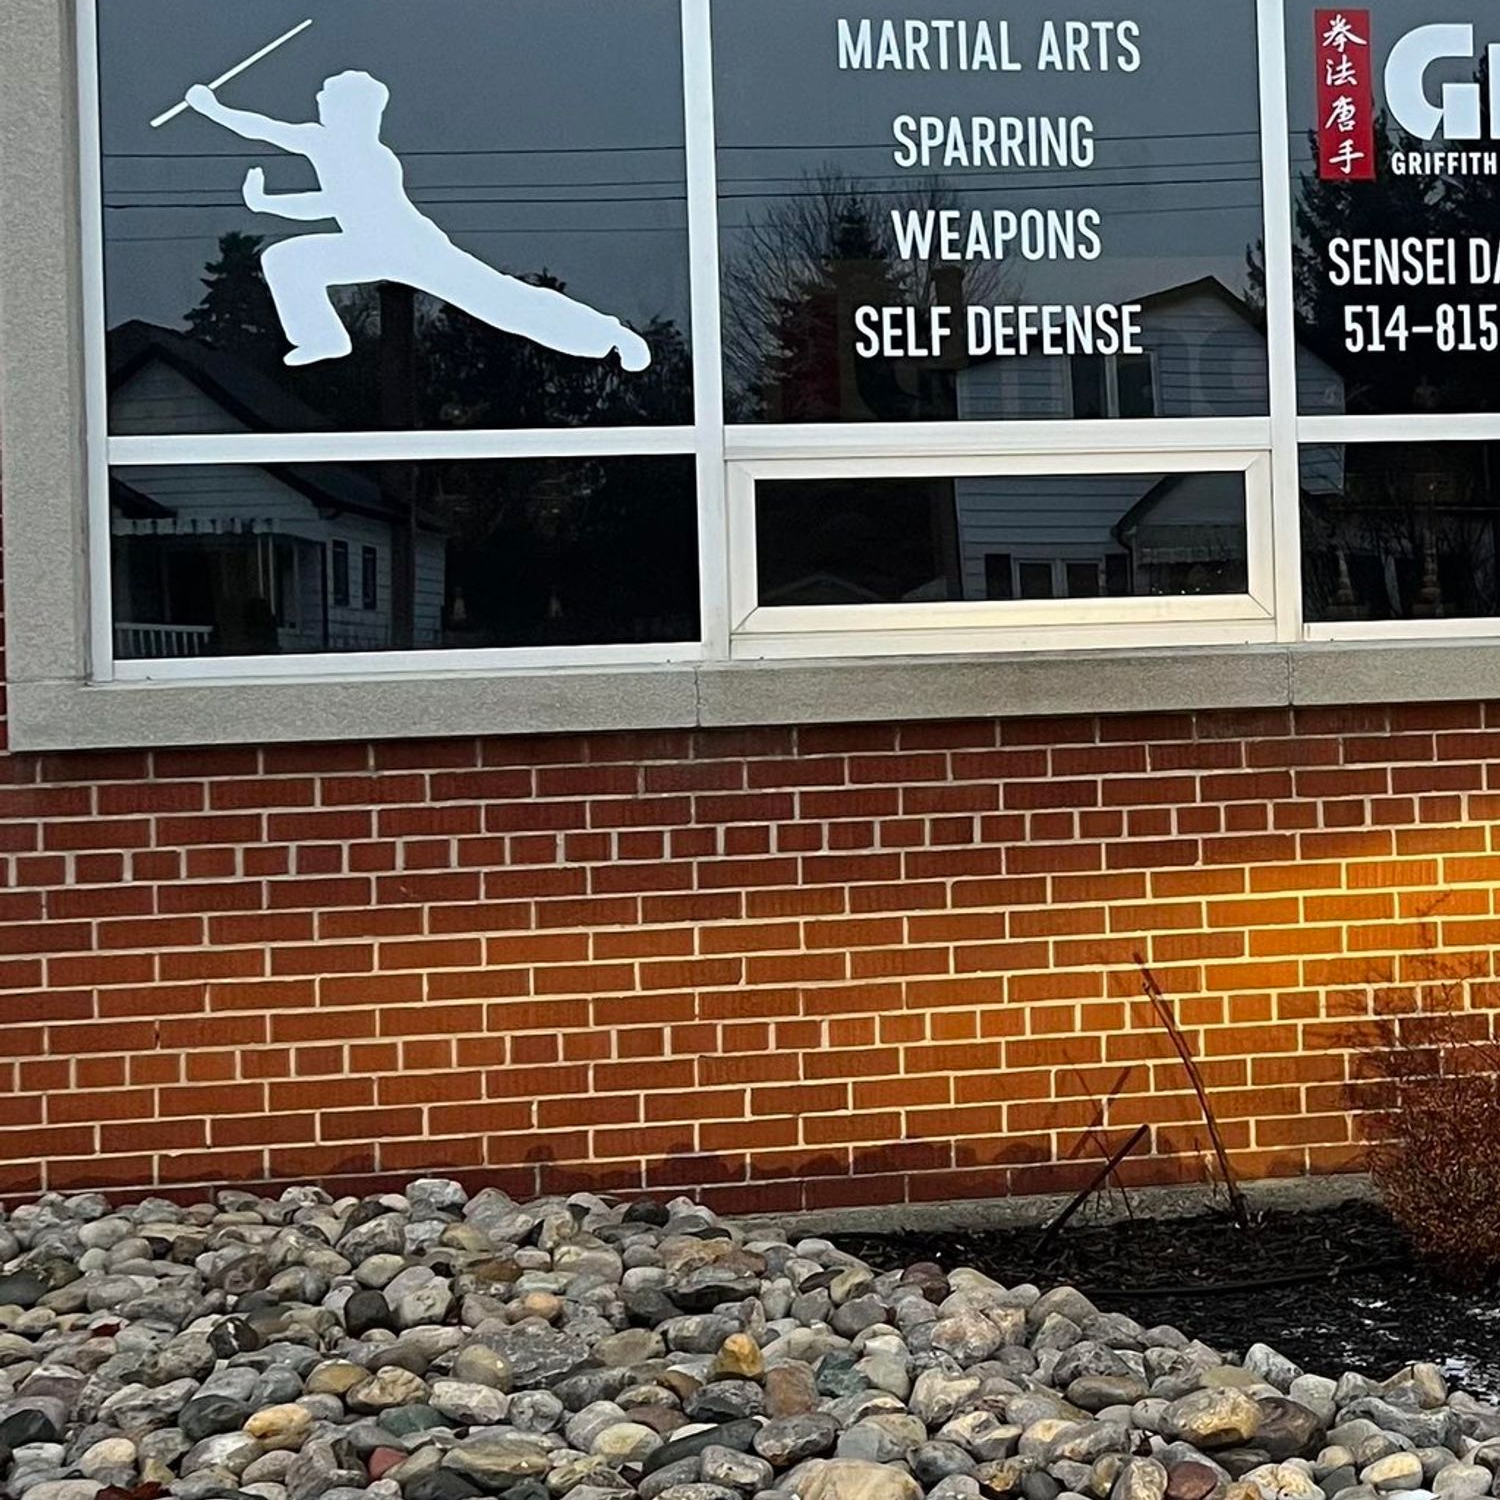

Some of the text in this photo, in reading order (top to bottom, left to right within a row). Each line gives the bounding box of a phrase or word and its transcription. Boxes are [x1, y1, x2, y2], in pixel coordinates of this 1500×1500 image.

[837, 18, 1141, 72] MARTIAL ARTS
[893, 114, 1096, 168] SPARRING
[1391, 151, 1497, 175] GRIFFITH
[890, 208, 1102, 261] WEAPONS
[1328, 237, 1456, 286] SENSEI
[855, 303, 1143, 358] SELF DEFENSE
